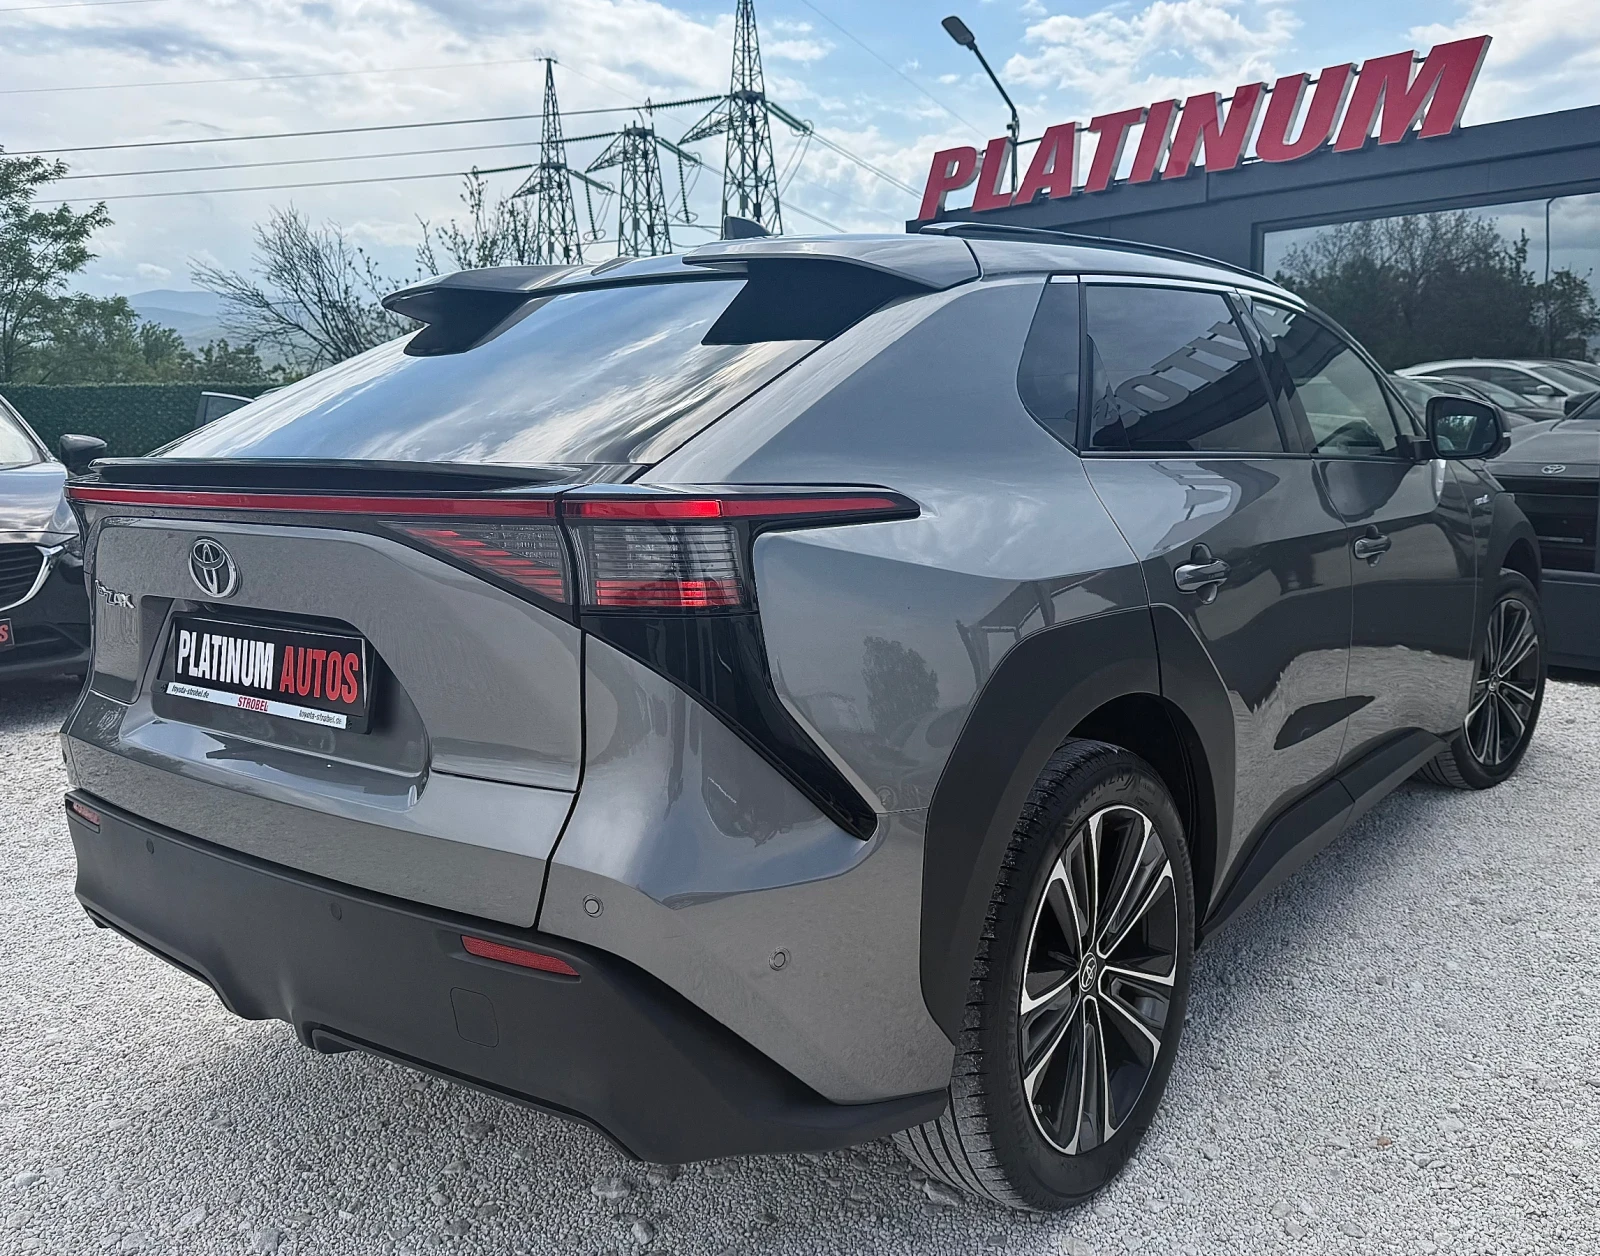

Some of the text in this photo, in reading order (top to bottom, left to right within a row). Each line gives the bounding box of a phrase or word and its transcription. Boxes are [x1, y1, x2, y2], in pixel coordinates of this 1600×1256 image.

[918, 35, 1492, 221] PLATINUM
[176, 629, 359, 704] PLATINUM AUTOS
[171, 684, 342, 725] toyota-strobel.de STROBEL toyota-strobel.de
